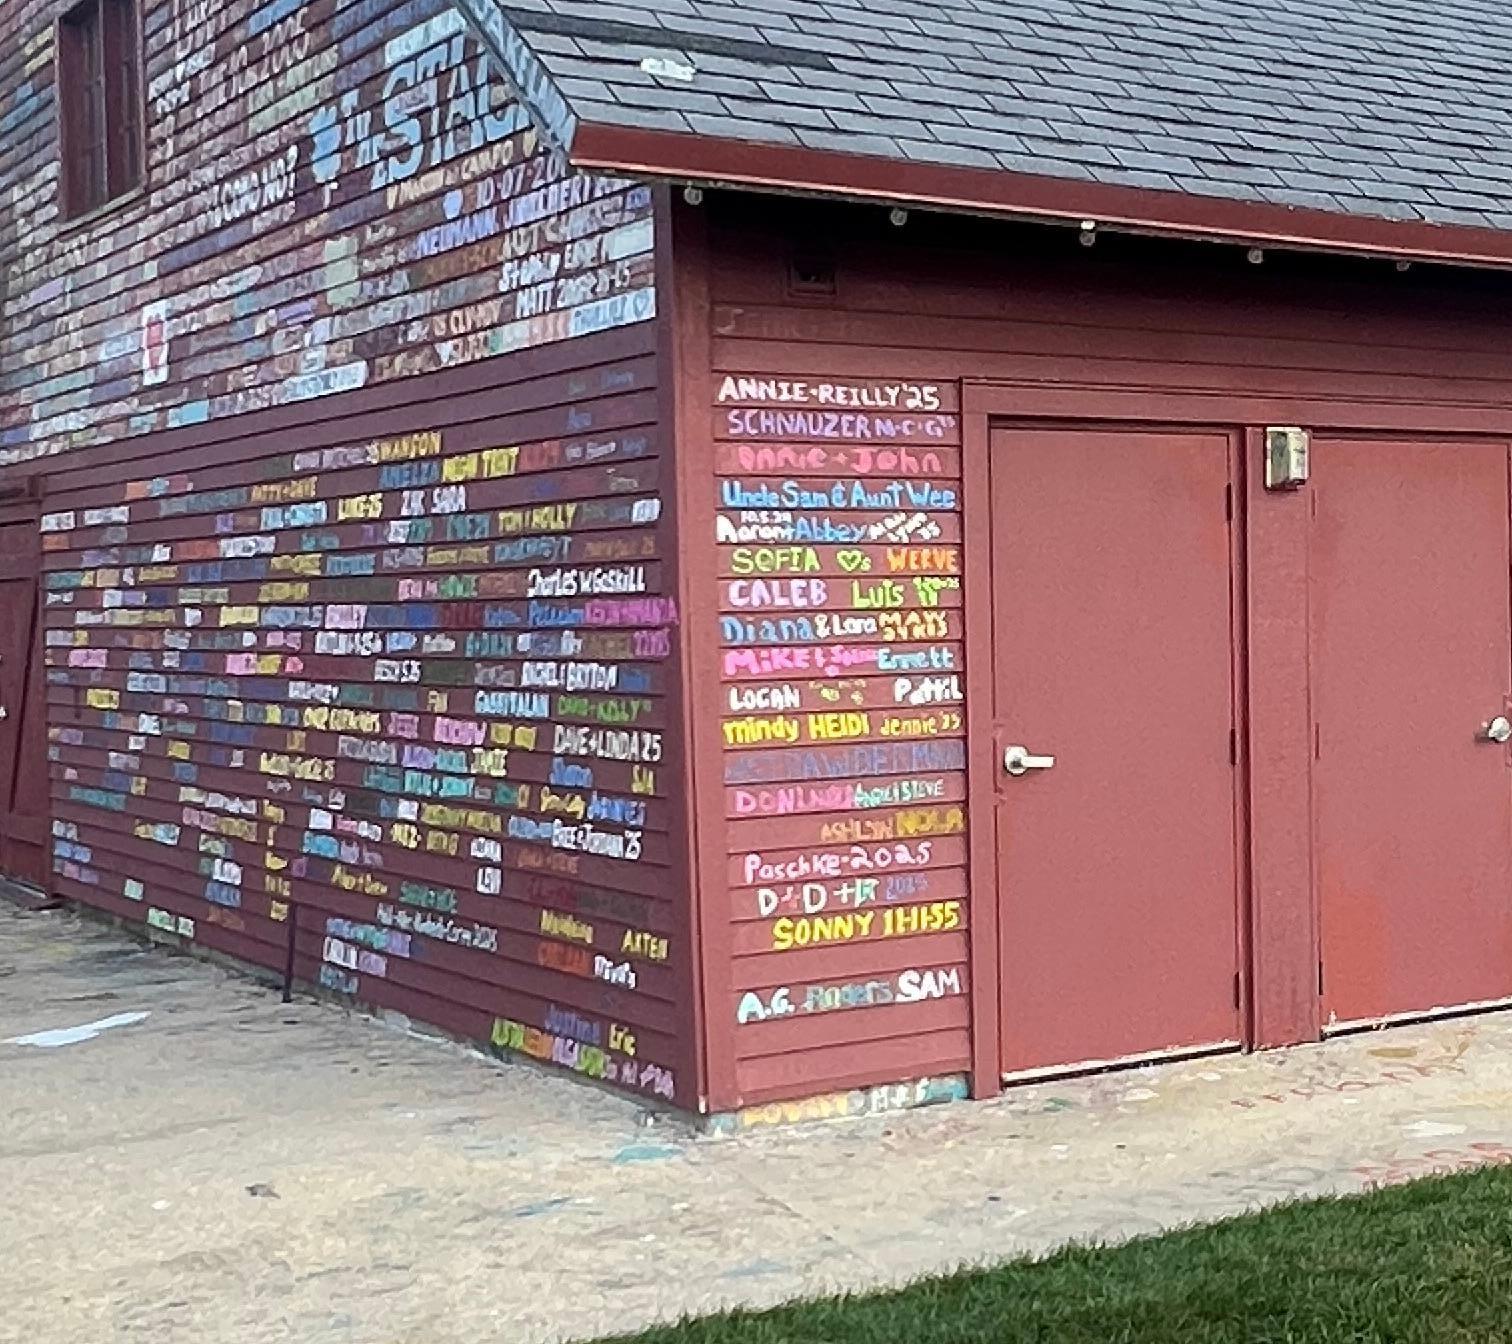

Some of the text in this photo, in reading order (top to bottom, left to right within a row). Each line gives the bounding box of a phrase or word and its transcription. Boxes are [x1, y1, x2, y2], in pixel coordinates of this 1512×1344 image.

[728, 578, 829, 607] CALEB
[808, 712, 870, 740] HEIDI
[772, 909, 874, 952] SONNY
[895, 968, 961, 1003] SAM
